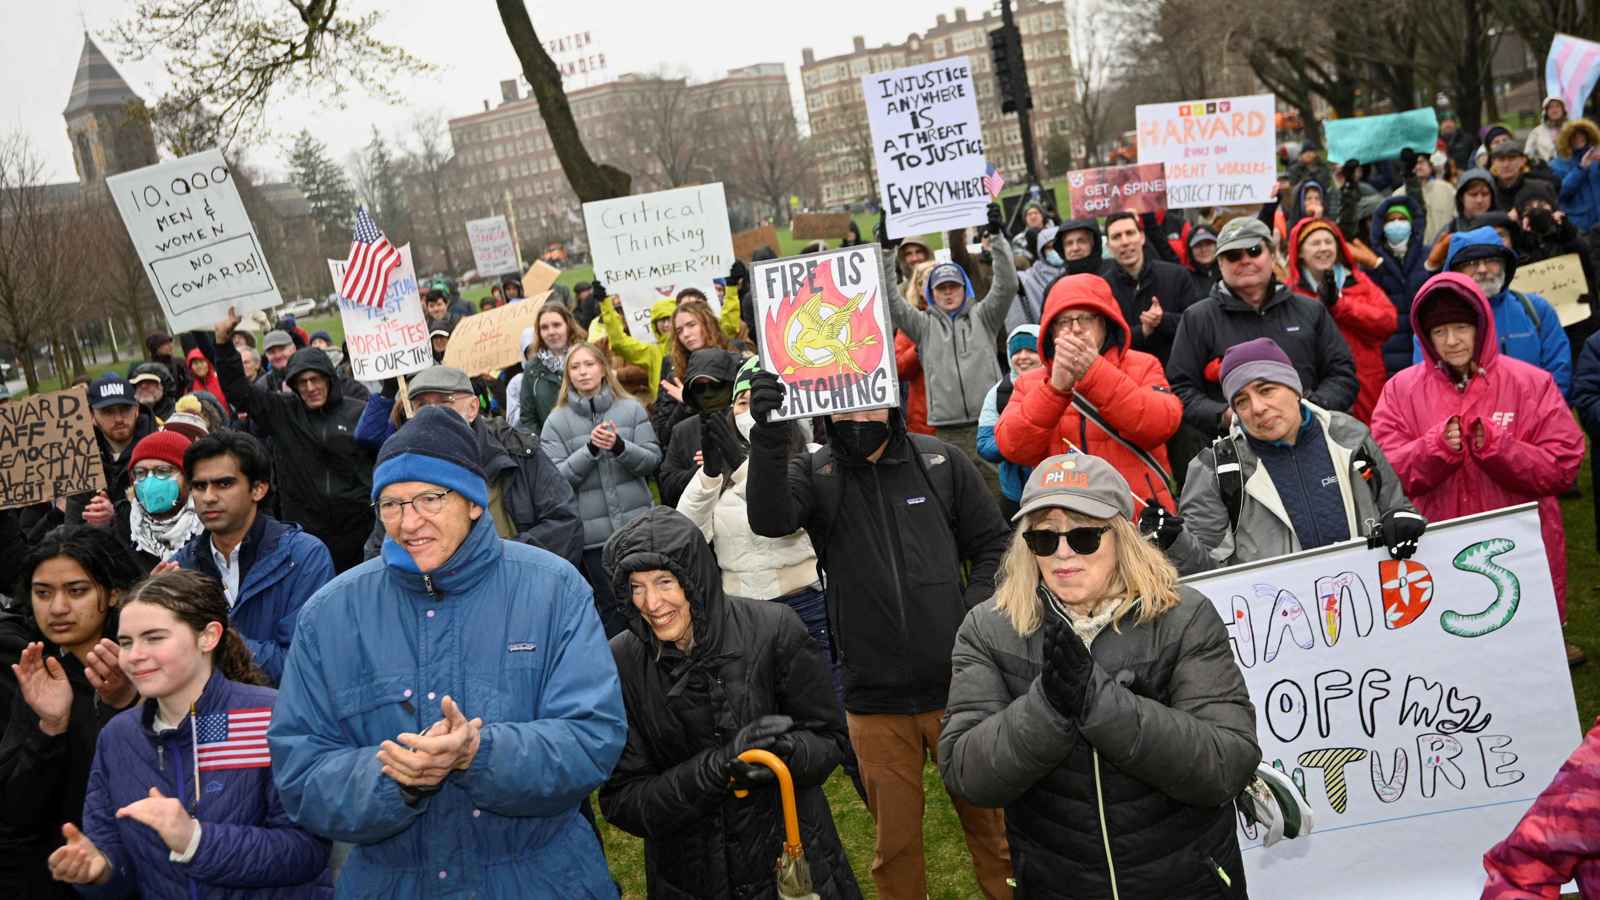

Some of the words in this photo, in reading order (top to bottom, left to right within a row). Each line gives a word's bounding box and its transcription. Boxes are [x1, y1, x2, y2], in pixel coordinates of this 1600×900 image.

[887, 84, 966, 116] ANYWHERE
[883, 140, 899, 153] A
[898, 122, 968, 149] THREAT
[1140, 111, 1266, 146] HARVARD
[891, 152, 922, 171] TO
[131, 166, 230, 213] 10,000
[886, 176, 990, 215] EVERYWHERE
[1084, 183, 1109, 197] GET
[1111, 185, 1121, 198] A
[156, 207, 193, 232] MEN
[601, 191, 705, 230] Critical
[155, 223, 224, 252] WOMEN
[610, 226, 705, 255] Thinking
[170, 253, 261, 298] COWARDS!
[190, 252, 213, 271] NO
[765, 259, 824, 299] FIRE
[837, 251, 865, 288] IS
[347, 331, 398, 354] MORAL
[353, 357, 369, 377] OF
[375, 350, 410, 373] OUR
[100, 383, 124, 398] UAW
[53, 477, 97, 498] BACK!
[1265, 668, 1391, 743] OFF
